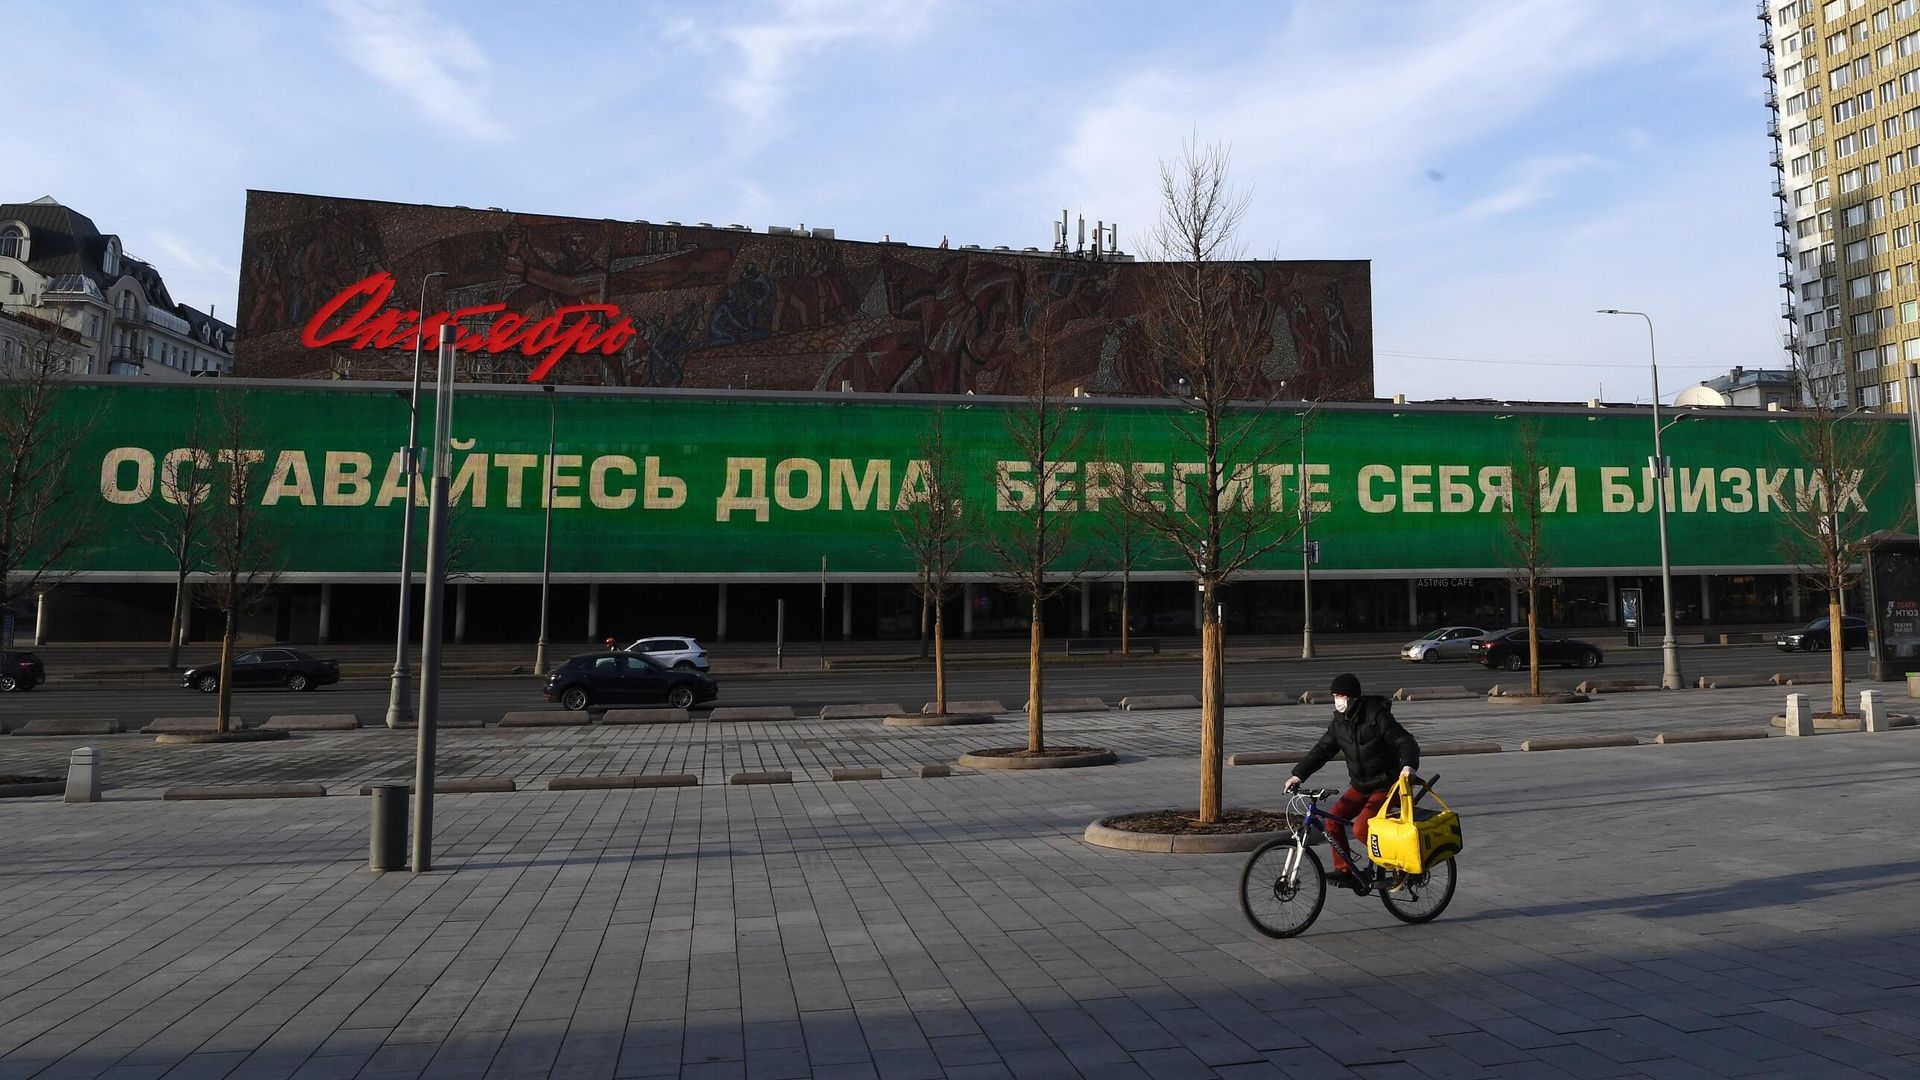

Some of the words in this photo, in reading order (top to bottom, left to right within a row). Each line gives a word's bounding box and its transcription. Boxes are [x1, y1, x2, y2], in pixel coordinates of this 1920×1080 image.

[100, 438, 688, 510] ОСТАВАЙТЕСЬ
[716, 457, 963, 522] ДОМА,
[996, 460, 1331, 513] БЕРЕГИТЕ
[1358, 464, 1514, 513] СЕБЯ
[1540, 466, 1578, 513] И
[1602, 467, 1868, 514] БЛИЗКИХ
